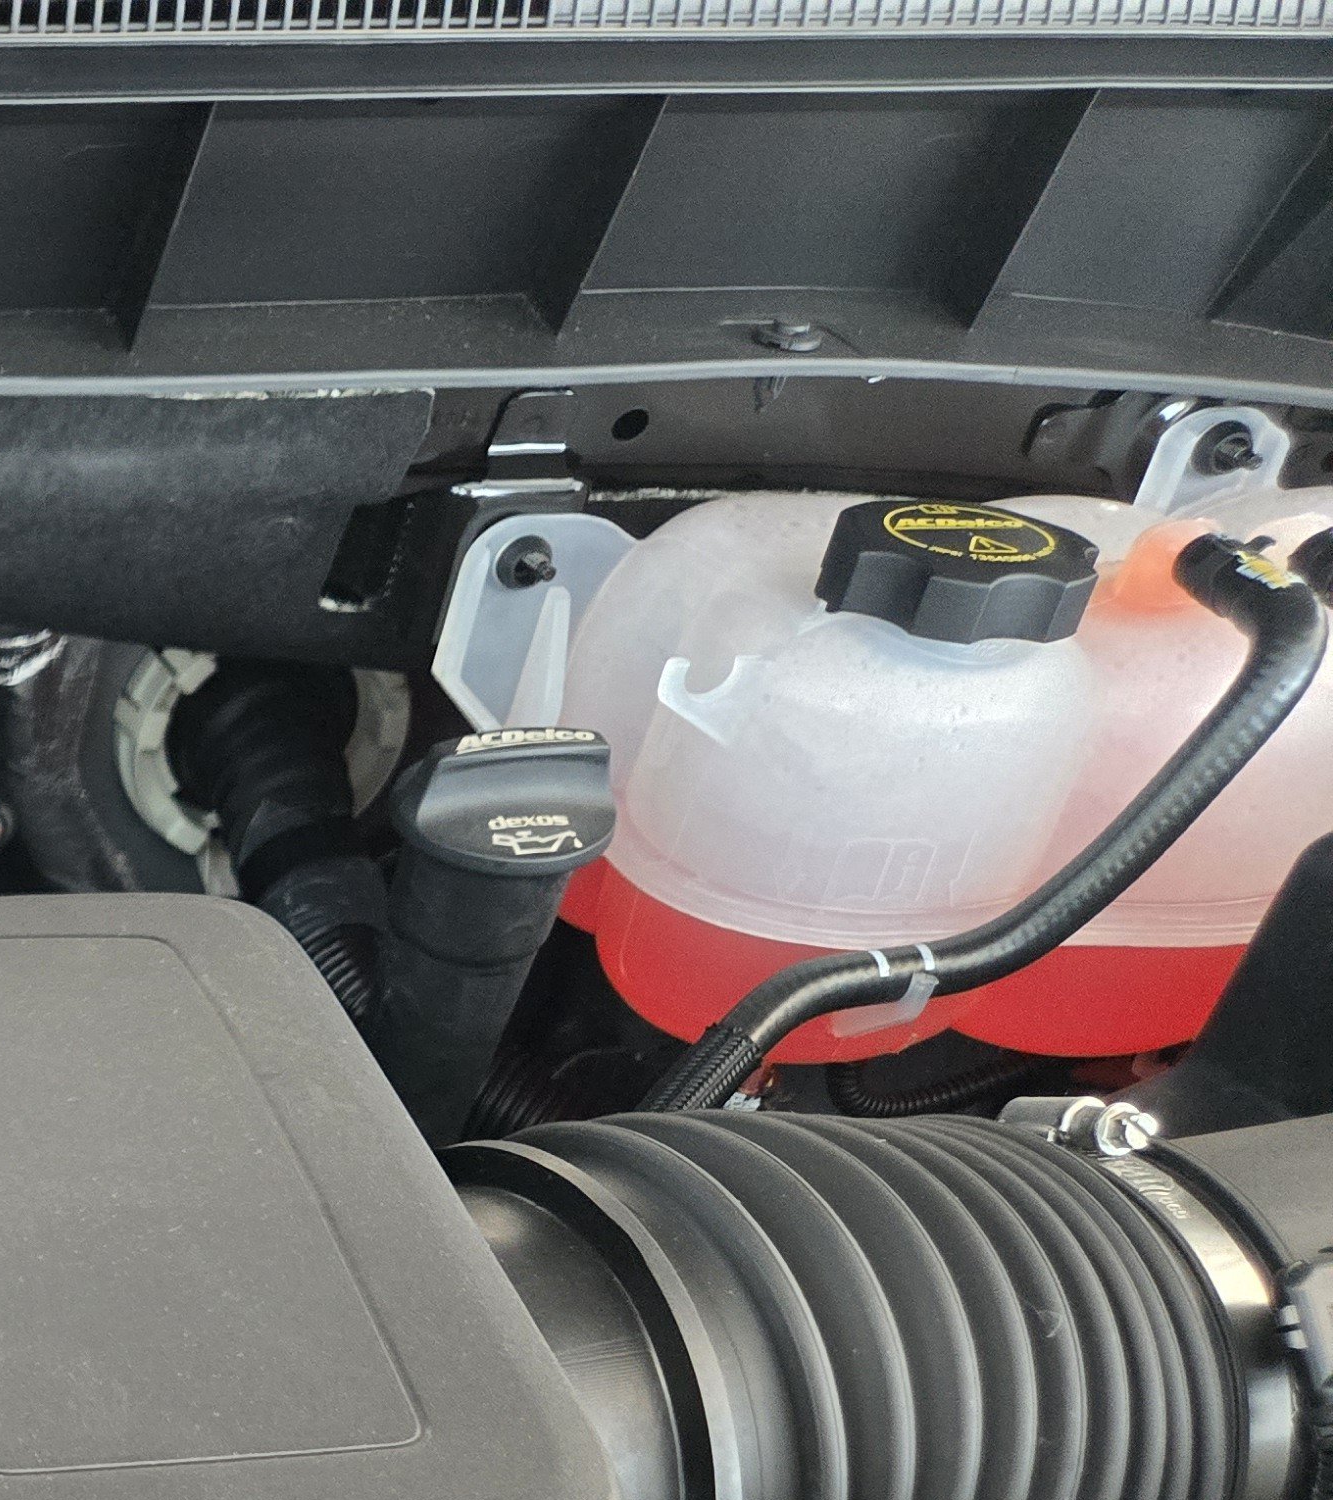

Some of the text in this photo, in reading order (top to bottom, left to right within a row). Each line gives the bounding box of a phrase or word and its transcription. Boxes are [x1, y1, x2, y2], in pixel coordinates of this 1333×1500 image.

[893, 518, 1024, 530] ACDelco
[455, 728, 595, 755] ACDelco
[488, 815, 569, 830] dexos
